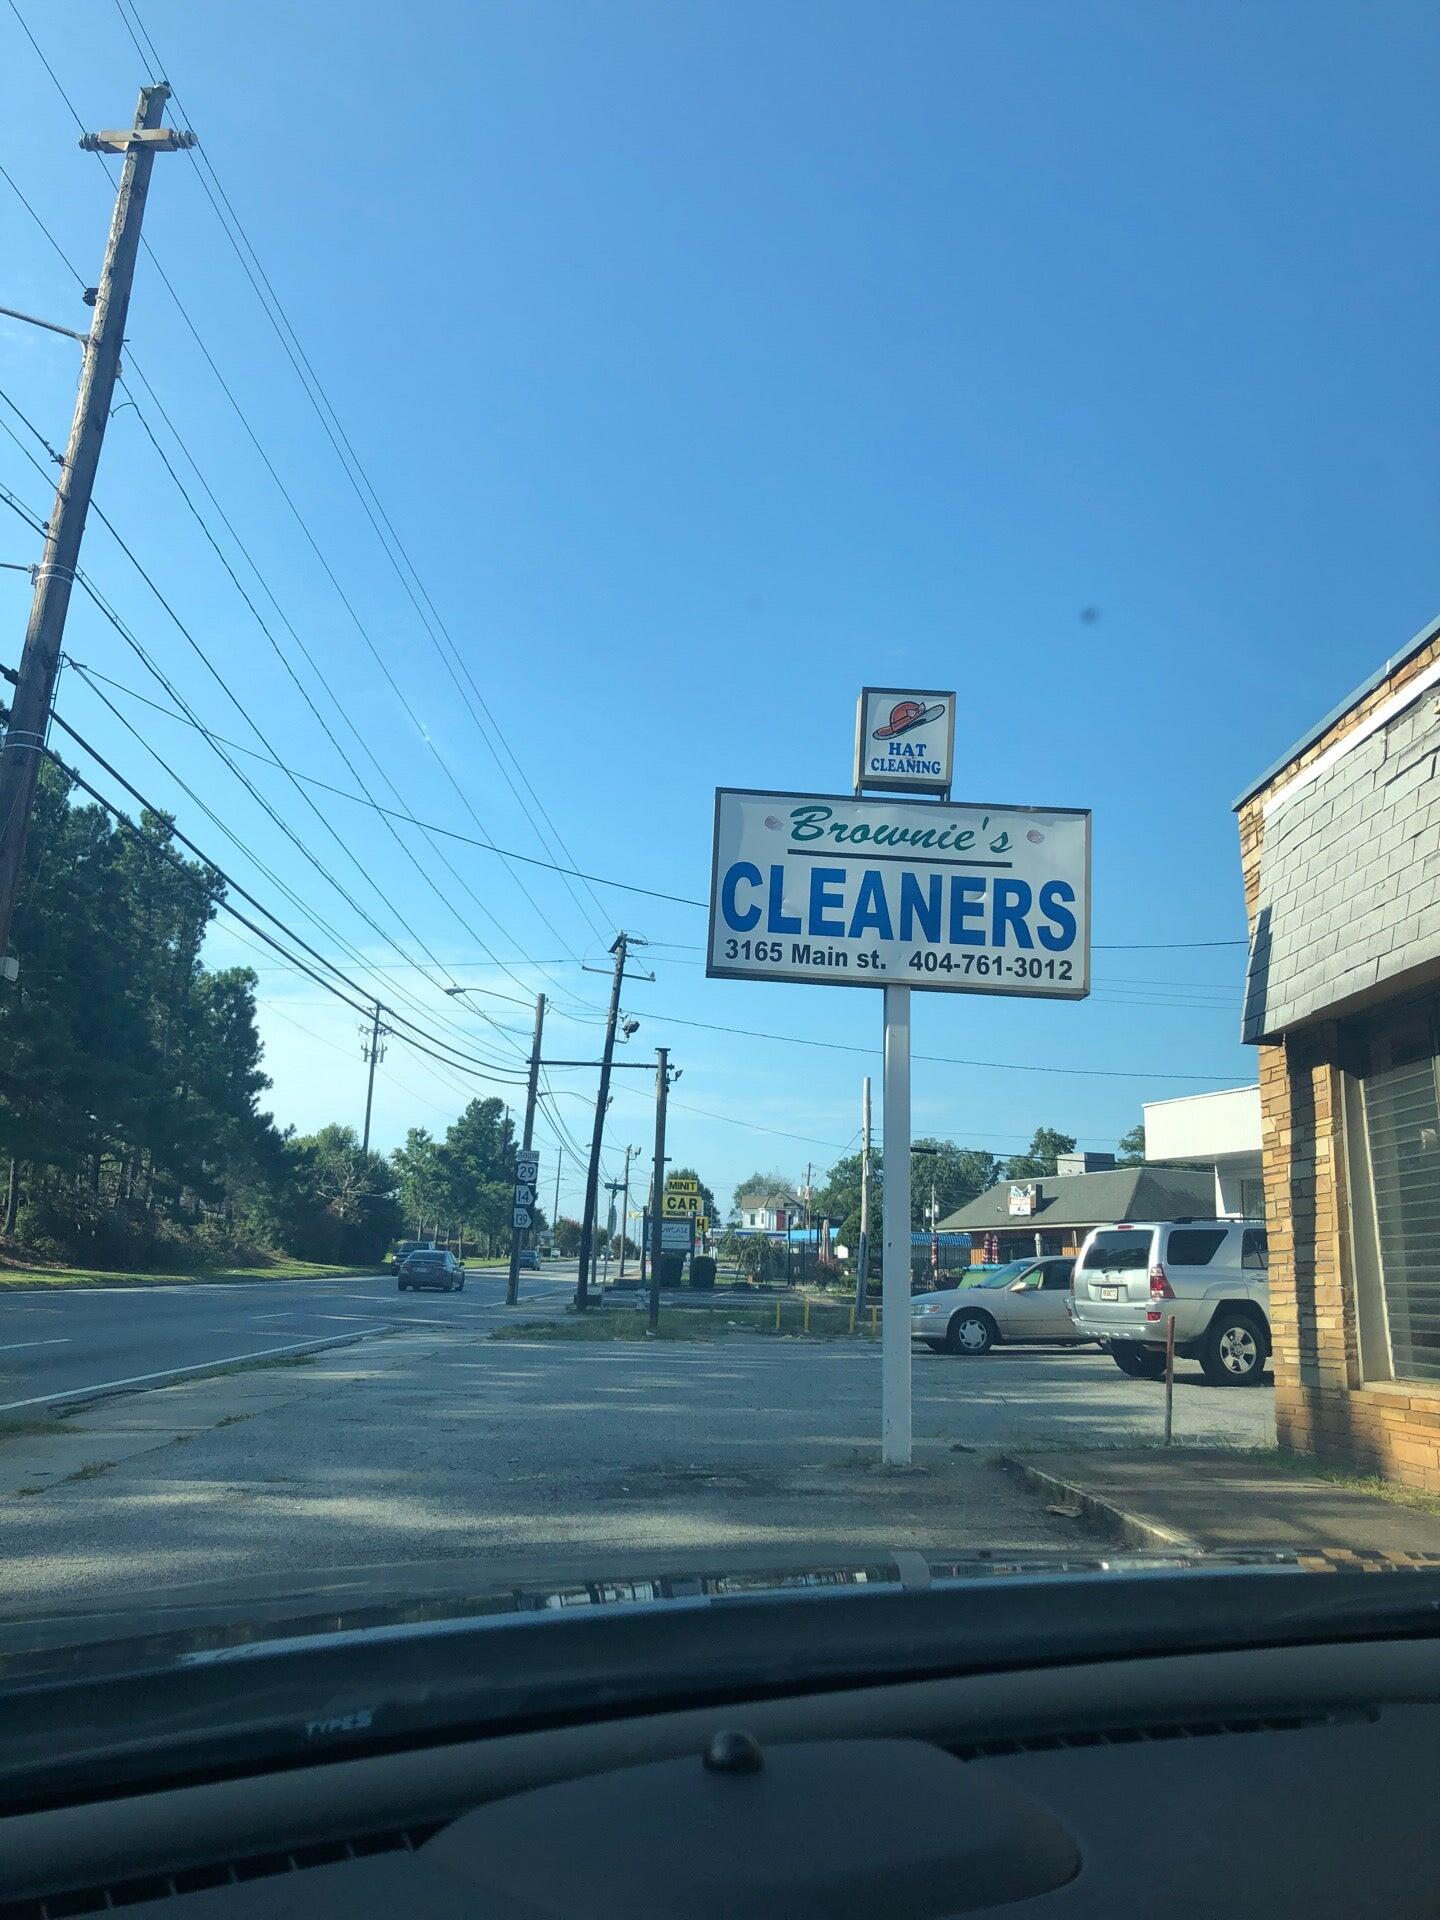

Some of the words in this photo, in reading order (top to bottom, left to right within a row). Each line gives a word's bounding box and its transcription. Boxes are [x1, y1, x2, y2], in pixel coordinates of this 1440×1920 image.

[888, 742, 927, 757] HAT
[870, 757, 942, 775] CLEANING
[789, 805, 1013, 854] Brownie's
[721, 861, 1077, 952] CLEANERS
[725, 938, 783, 963] 3165
[791, 943, 848, 967] Main
[856, 949, 887, 970] st.
[908, 950, 1073, 981] 404-761-3012
[518, 1151, 539, 1161] SOUTH
[519, 1166, 535, 1178] 29
[668, 1181, 697, 1191] MINIT
[517, 1190, 529, 1202] 14
[667, 1196, 698, 1210] CAR
[515, 1213, 528, 1226] 139
